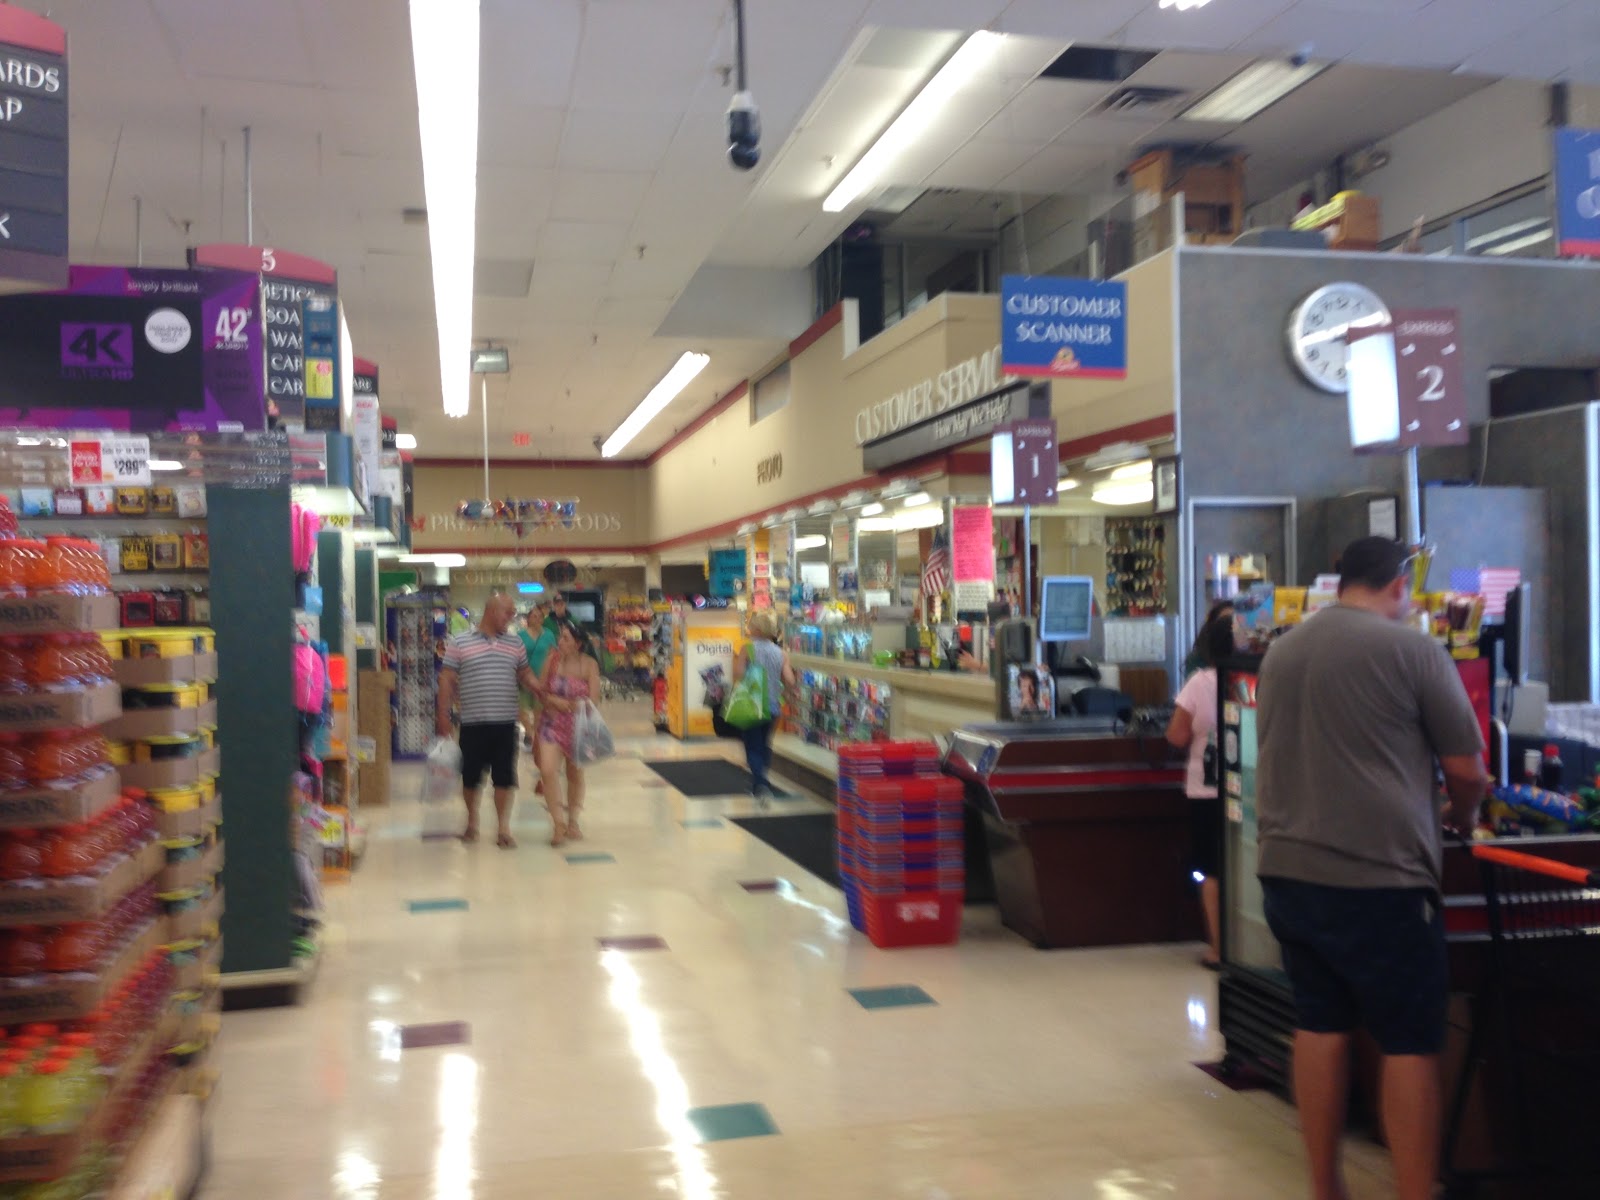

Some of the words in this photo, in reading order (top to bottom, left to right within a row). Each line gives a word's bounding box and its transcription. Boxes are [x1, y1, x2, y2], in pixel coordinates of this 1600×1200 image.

[0, 98, 23, 121] P
[261, 249, 276, 271] 5
[1006, 293, 1122, 319] CUSTOMER
[69, 327, 124, 362] 4K
[1015, 321, 1113, 345] SCANNER
[856, 377, 933, 446] CUSTOMER
[936, 343, 1019, 414] SERVIC
[1416, 364, 1446, 401] 2
[1030, 453, 1040, 479] 1
[697, 642, 733, 656] Digital
